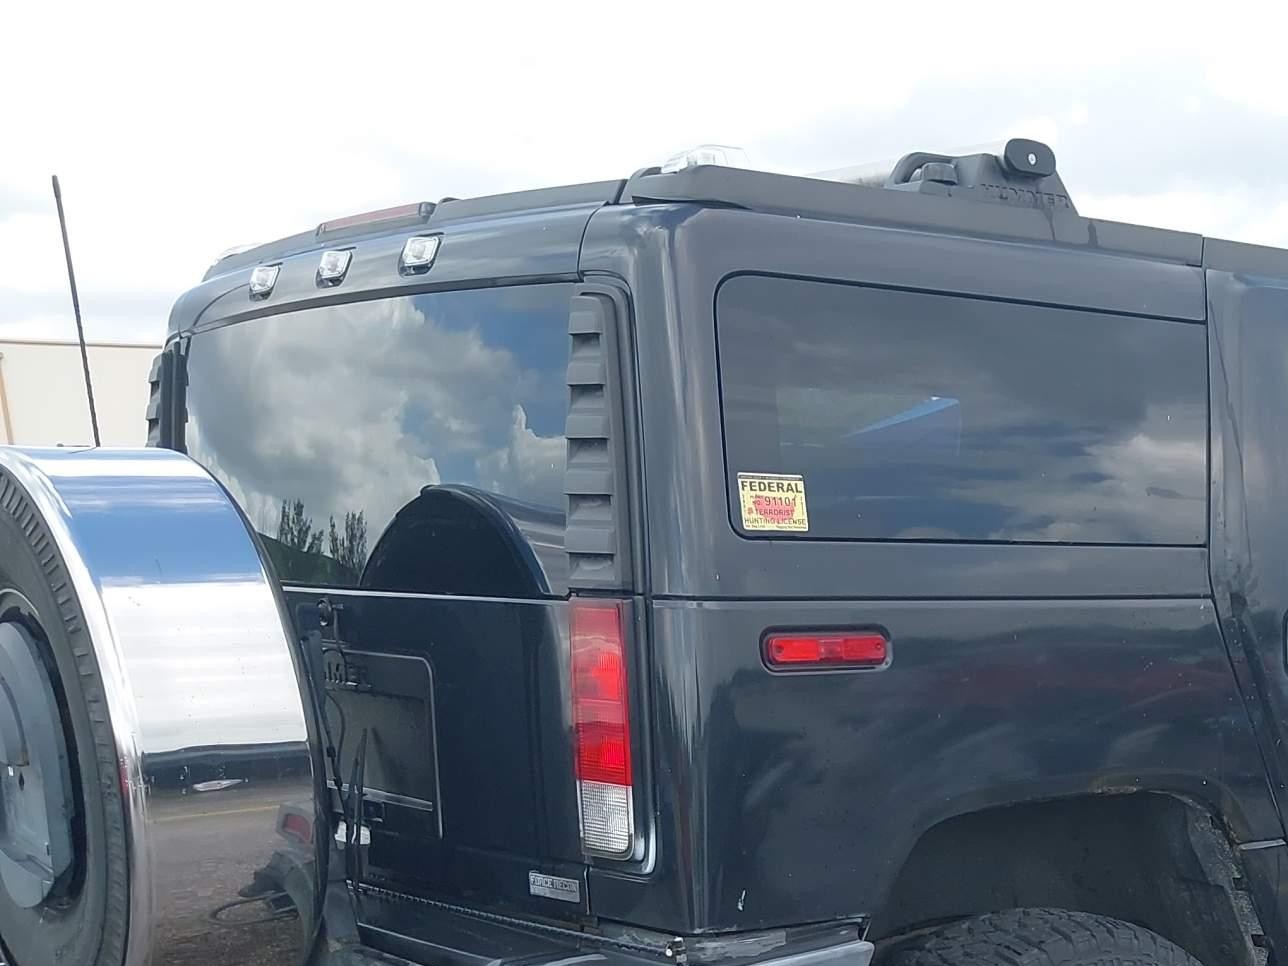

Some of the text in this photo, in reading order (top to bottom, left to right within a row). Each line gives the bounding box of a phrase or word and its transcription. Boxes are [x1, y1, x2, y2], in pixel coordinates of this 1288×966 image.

[741, 481, 803, 493] FEDERAL
[764, 495, 797, 507] 91101
[755, 508, 795, 516] TERRORIST
[744, 517, 807, 526] HUNTING LICENSE
[530, 875, 553, 888] FORCE
